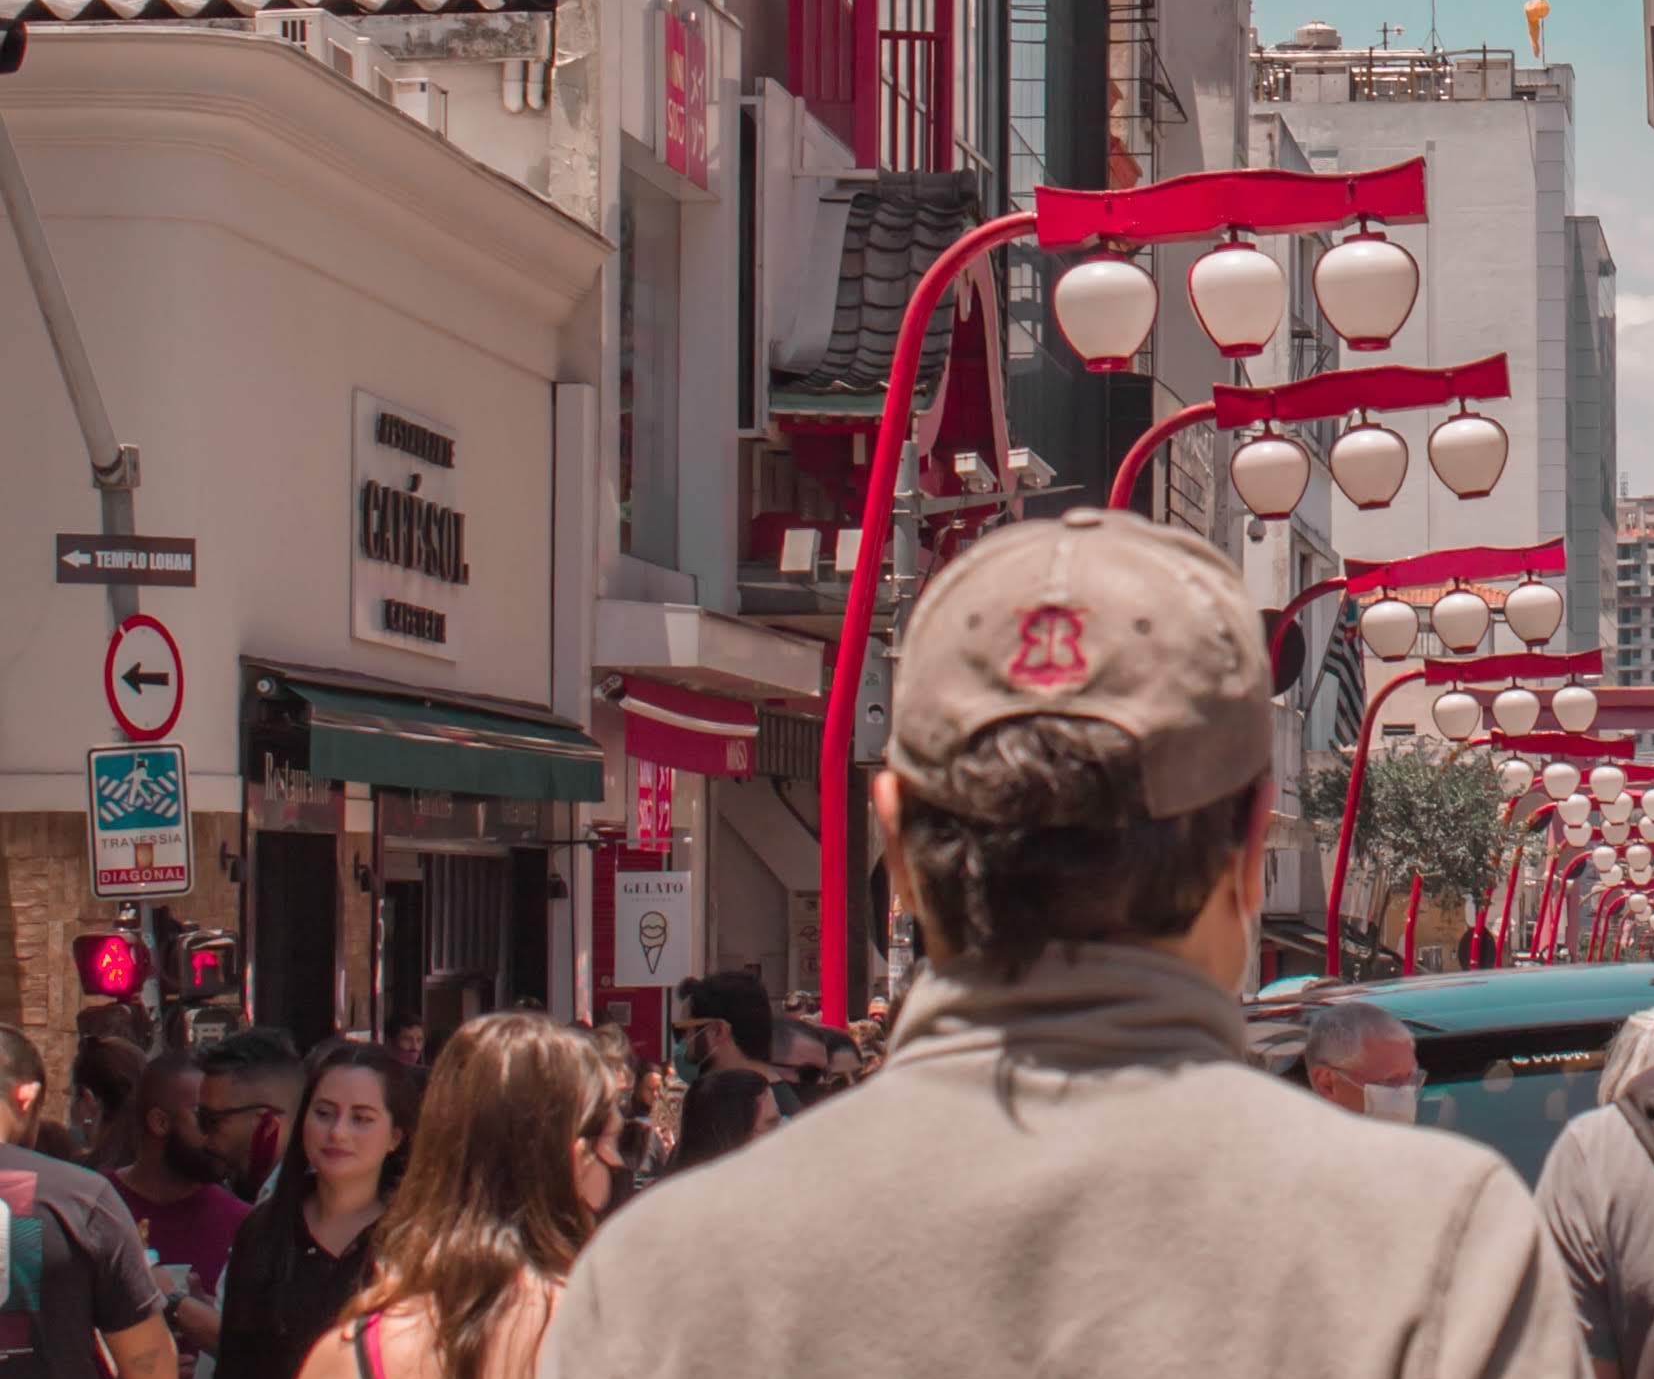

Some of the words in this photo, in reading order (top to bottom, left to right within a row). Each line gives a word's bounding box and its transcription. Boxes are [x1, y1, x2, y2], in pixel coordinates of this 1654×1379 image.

[96, 551, 147, 570] TEMPLO
[150, 553, 192, 571] LOHAN
[101, 833, 182, 849] TRAVESSIA
[101, 867, 184, 884] DIAGONAL
[623, 882, 684, 894] GELATO
